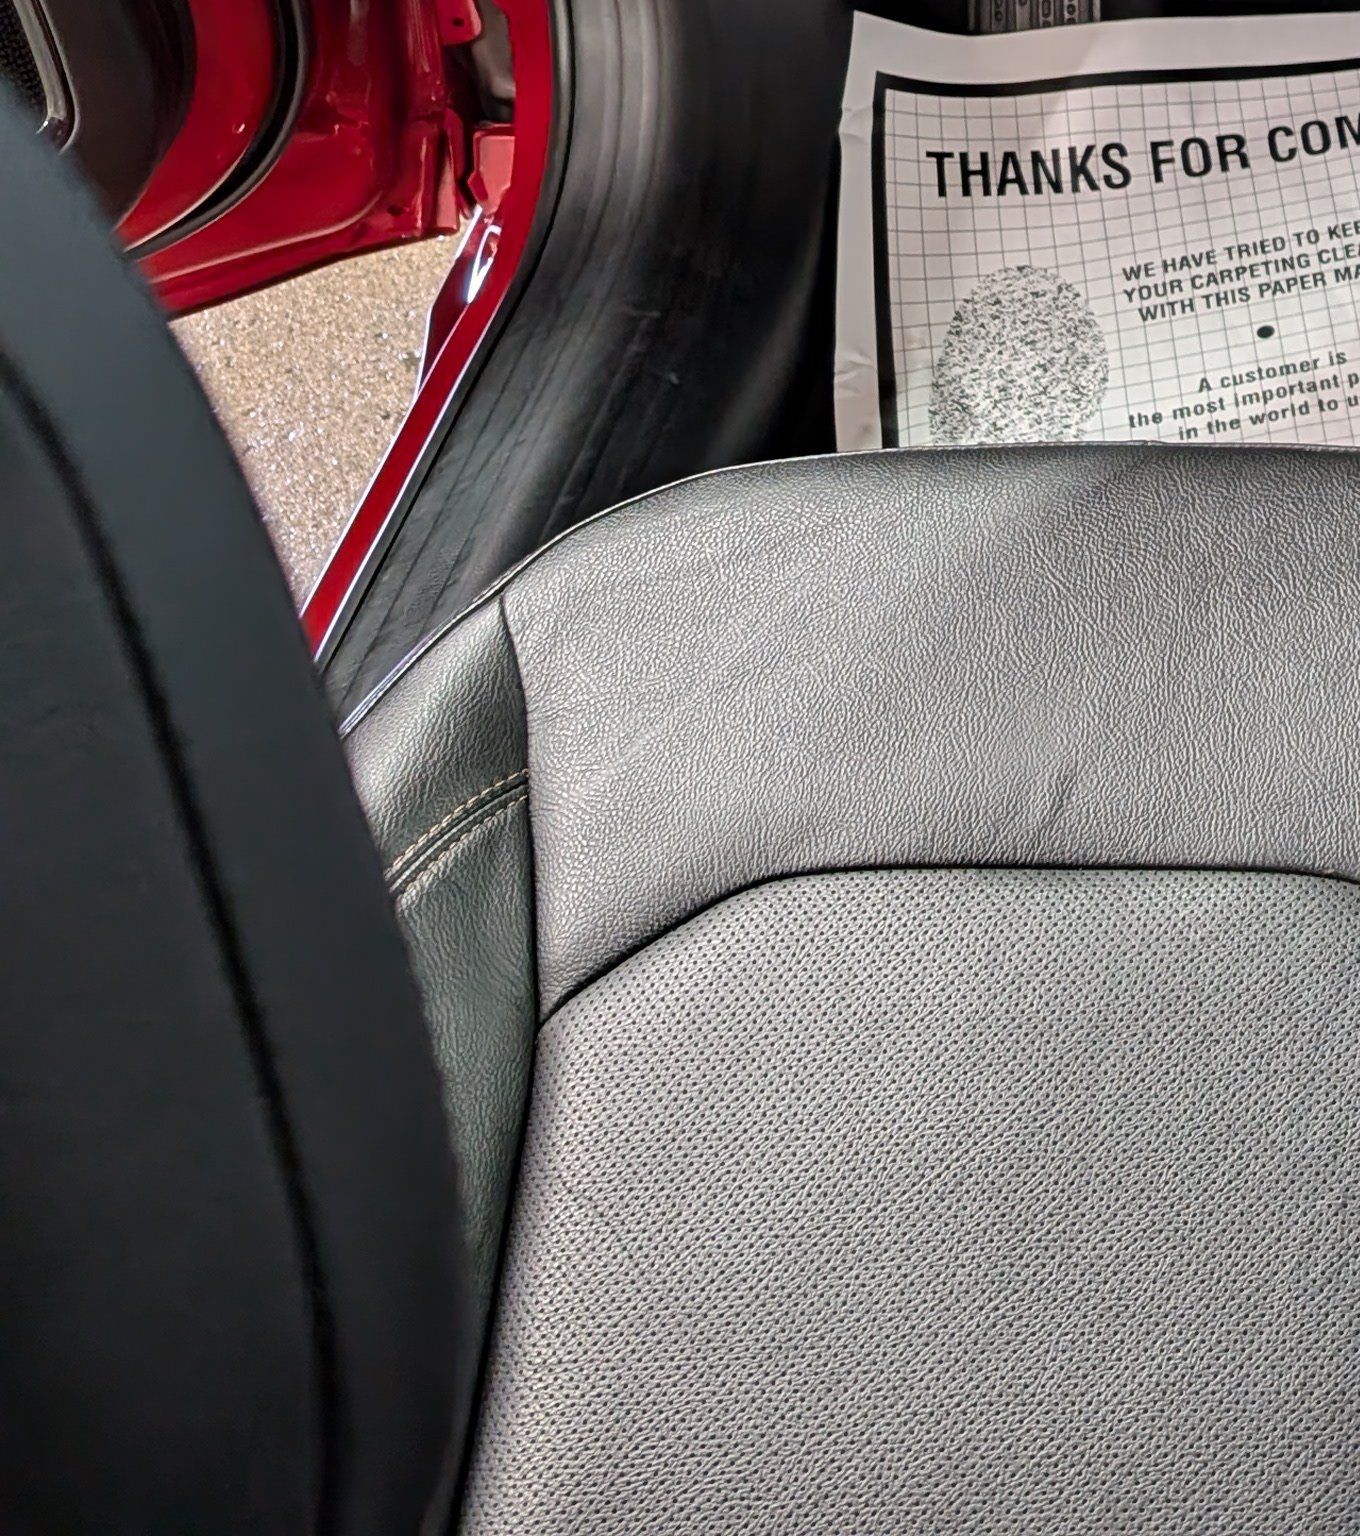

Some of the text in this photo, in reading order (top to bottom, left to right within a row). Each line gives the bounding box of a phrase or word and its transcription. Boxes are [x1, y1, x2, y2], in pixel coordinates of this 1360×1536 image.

[926, 142, 1132, 198] THANKS
[1150, 133, 1250, 184] FOR
[1122, 262, 1156, 282] WE
[1162, 249, 1218, 276] HAVE
[1223, 236, 1286, 262] TRIED
[1293, 229, 1320, 247] TO
[1123, 279, 1184, 304] YOUR
[1190, 253, 1311, 290] CARPETING
[1137, 298, 1195, 323] WITH
[1201, 287, 1251, 310] THIS
[1257, 272, 1327, 298] PAPER
[1197, 350, 1348, 393] A customer is
[1128, 411, 1164, 429] the
[1172, 397, 1226, 421] most
[1234, 374, 1340, 413] important
[1178, 426, 1199, 441] in
[1207, 415, 1242, 436] the
[1250, 400, 1311, 426] world
[1318, 396, 1339, 413] to
